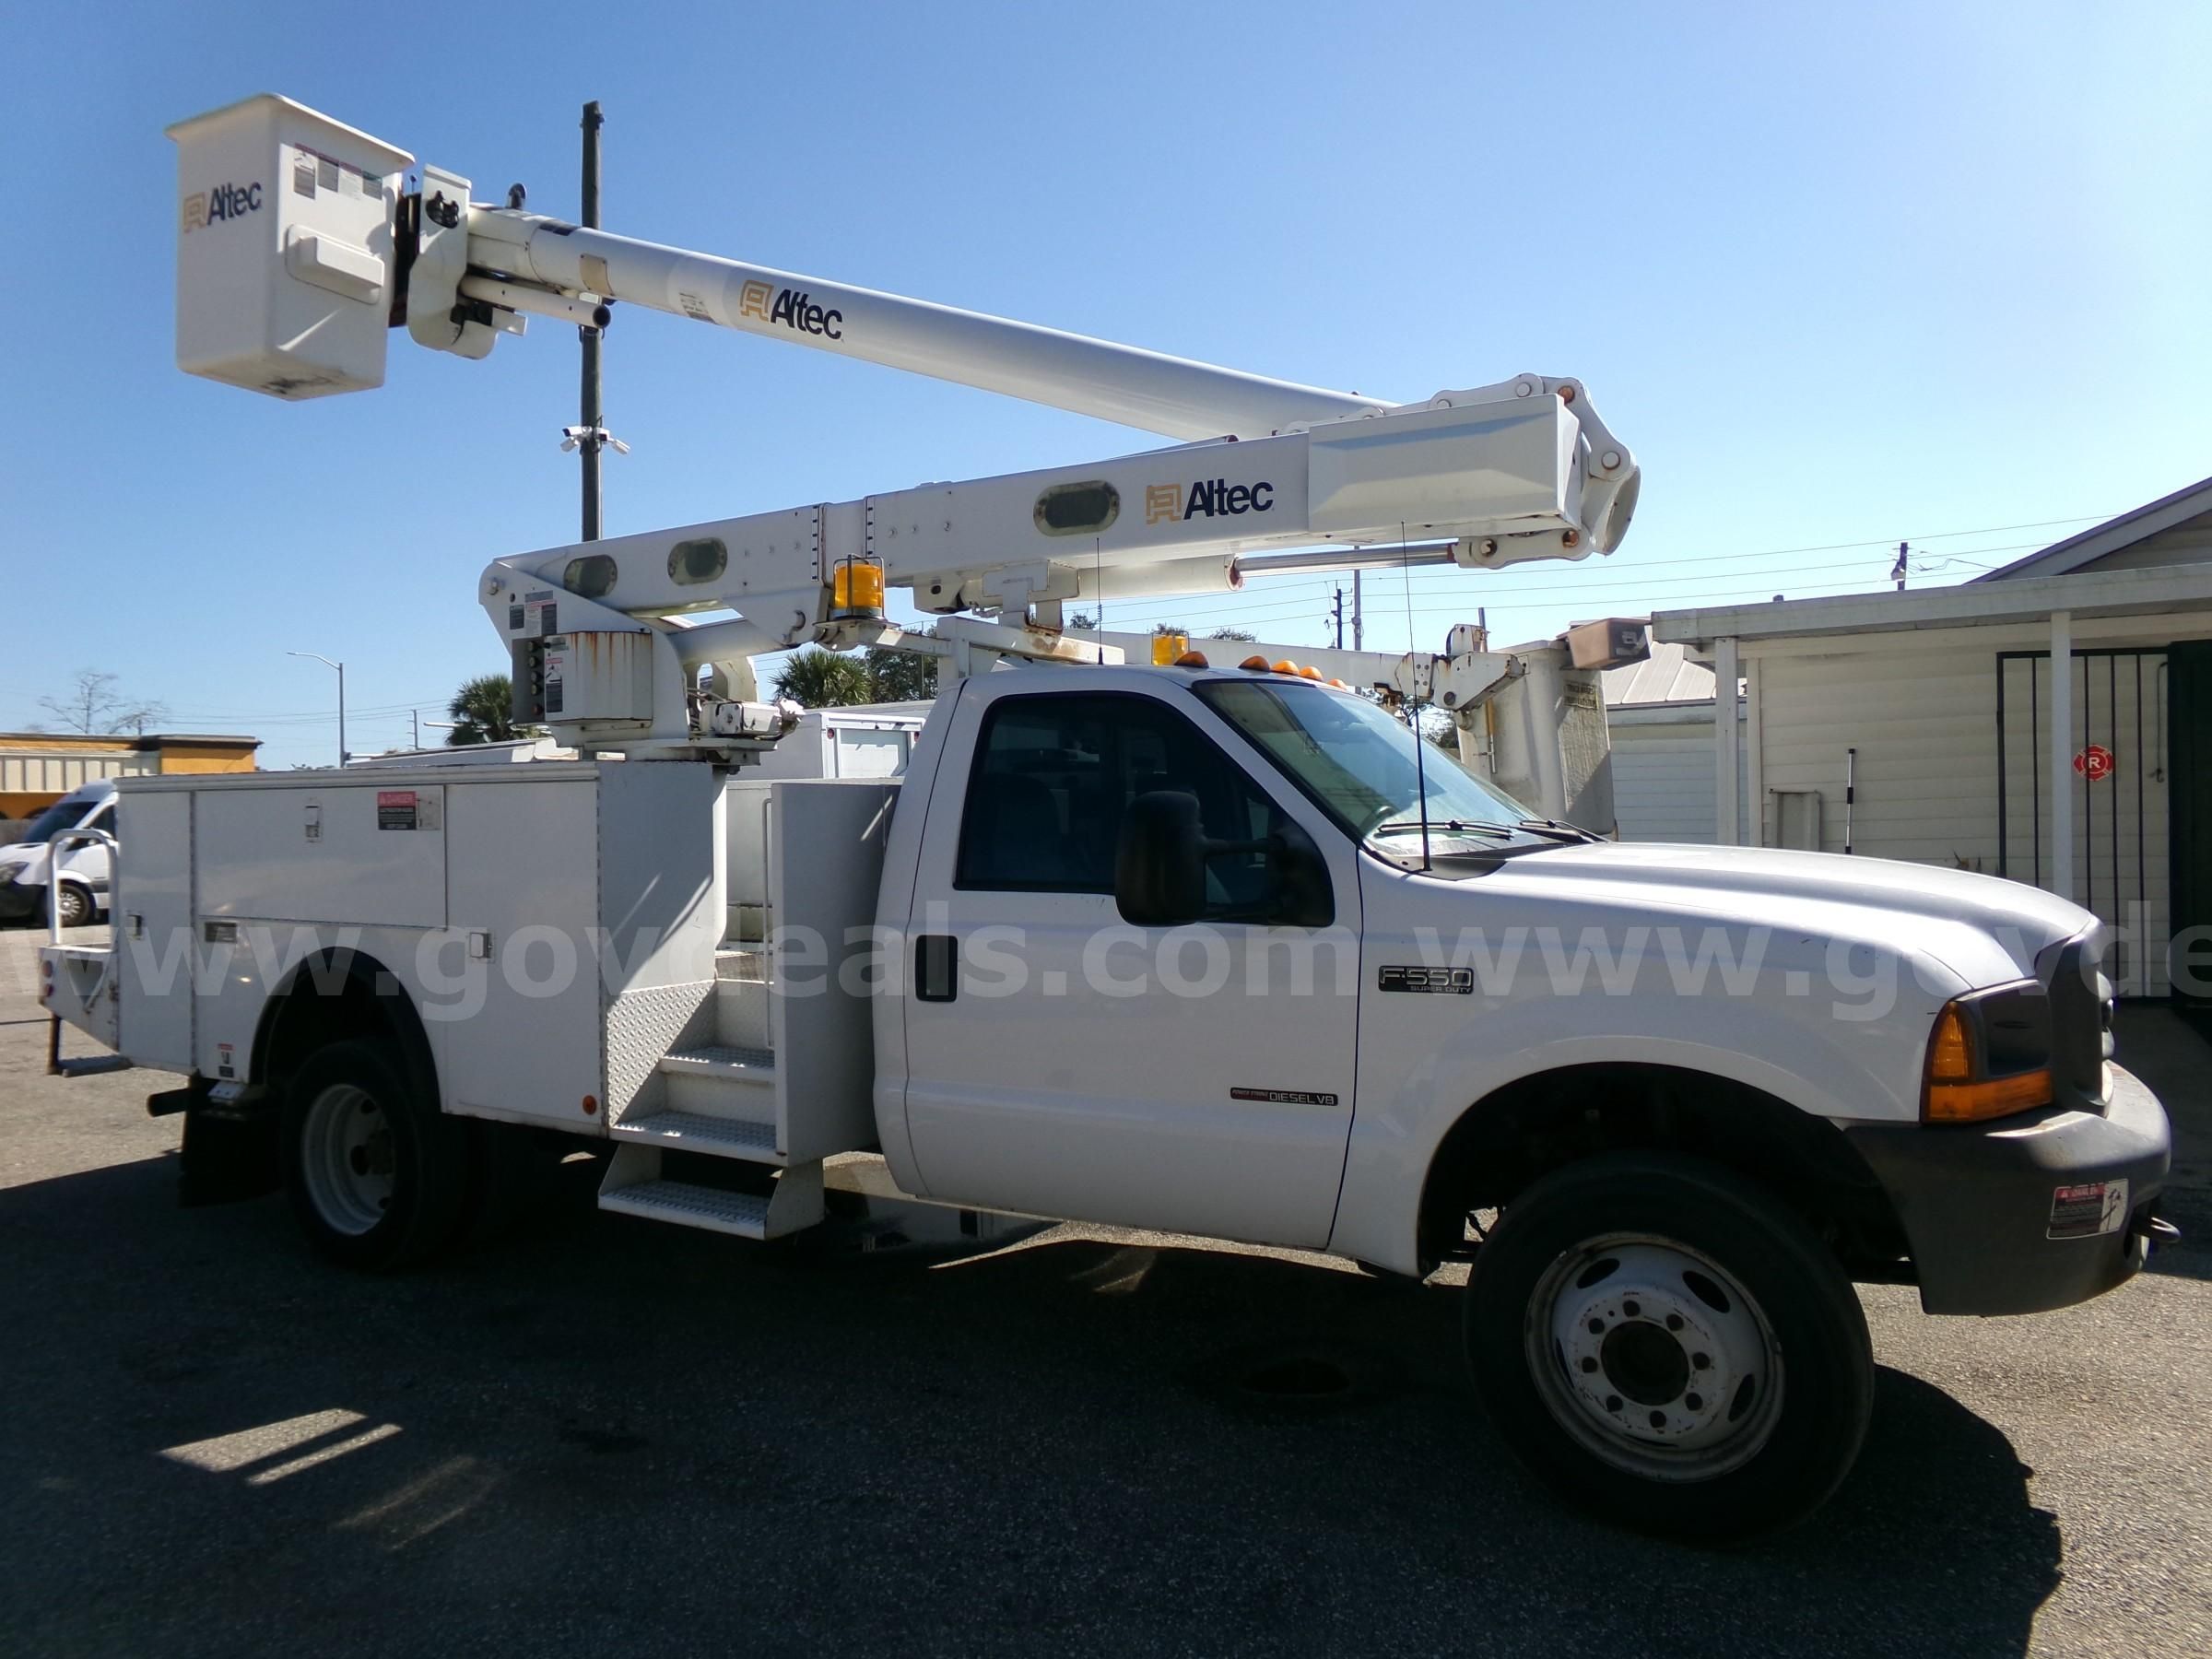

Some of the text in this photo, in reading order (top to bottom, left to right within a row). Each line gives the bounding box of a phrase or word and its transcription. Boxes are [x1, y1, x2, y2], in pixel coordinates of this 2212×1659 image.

[206, 182, 262, 226] Altec
[771, 288, 843, 340] Altec
[1183, 478, 1274, 520] Altec
[2088, 757, 2100, 769] R
[1269, 1091, 1315, 1104] DIESEL
[1316, 1094, 1335, 1105] V8
